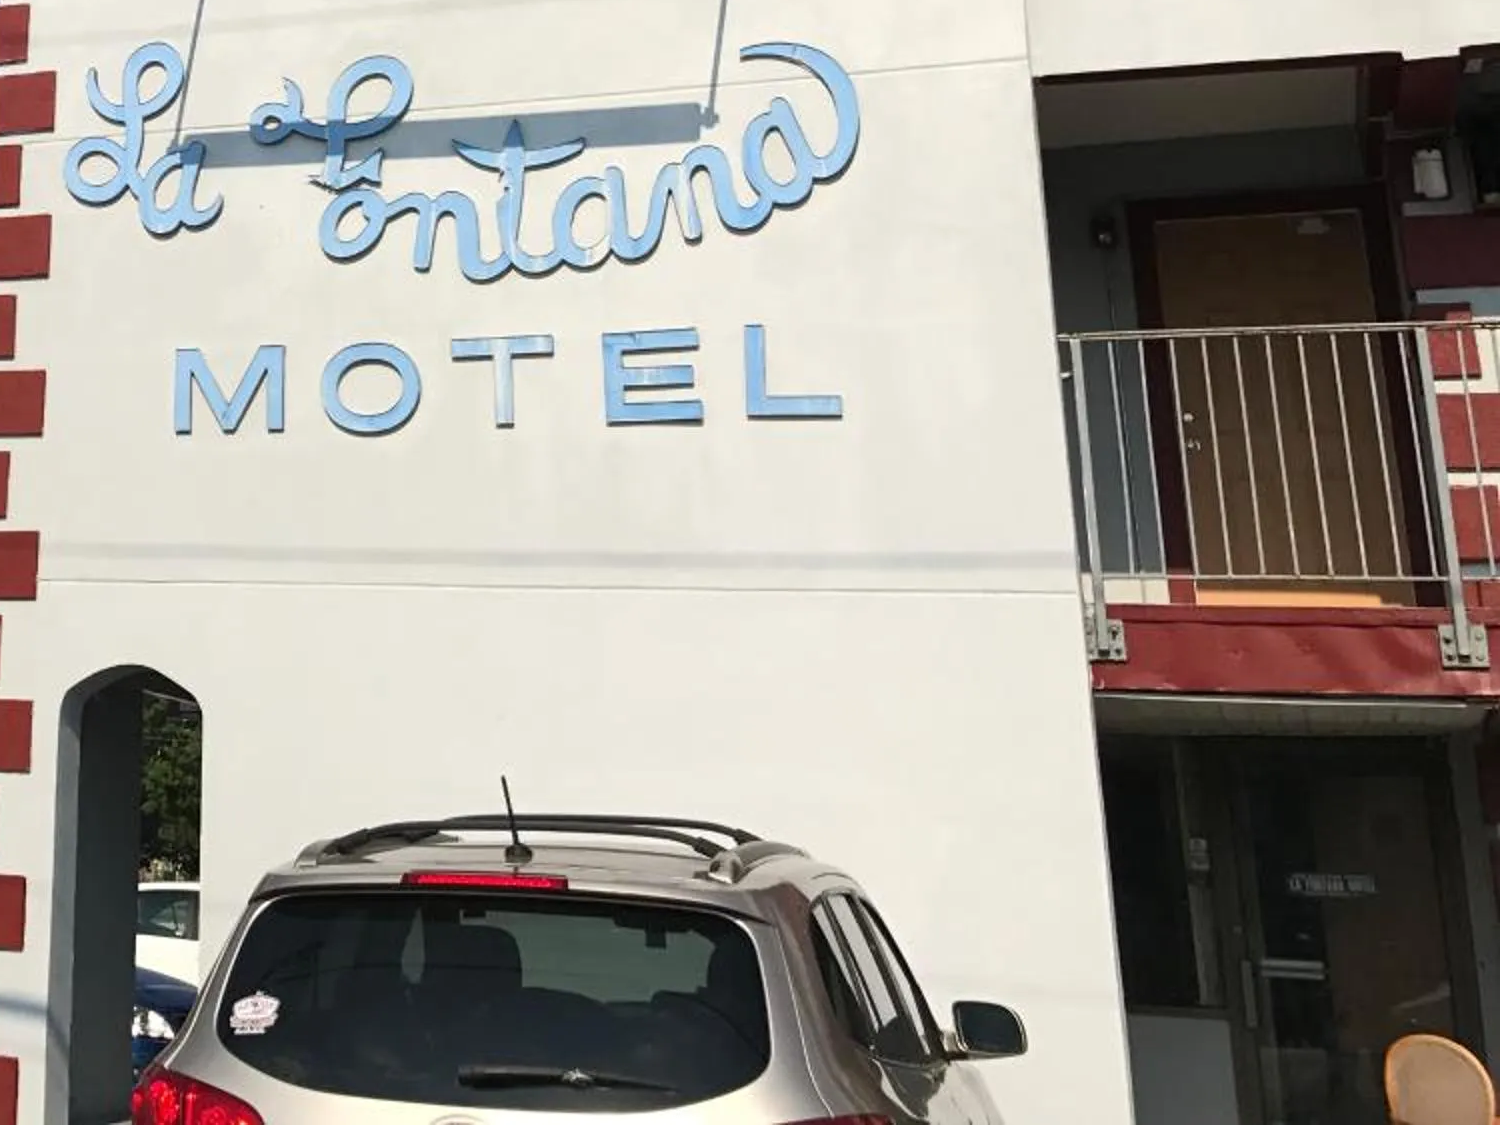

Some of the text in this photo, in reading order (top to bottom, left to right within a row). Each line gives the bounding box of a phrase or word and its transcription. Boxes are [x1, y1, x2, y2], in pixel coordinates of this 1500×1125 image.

[63, 40, 861, 283] La Fontana
[174, 324, 844, 436] MOTEL
